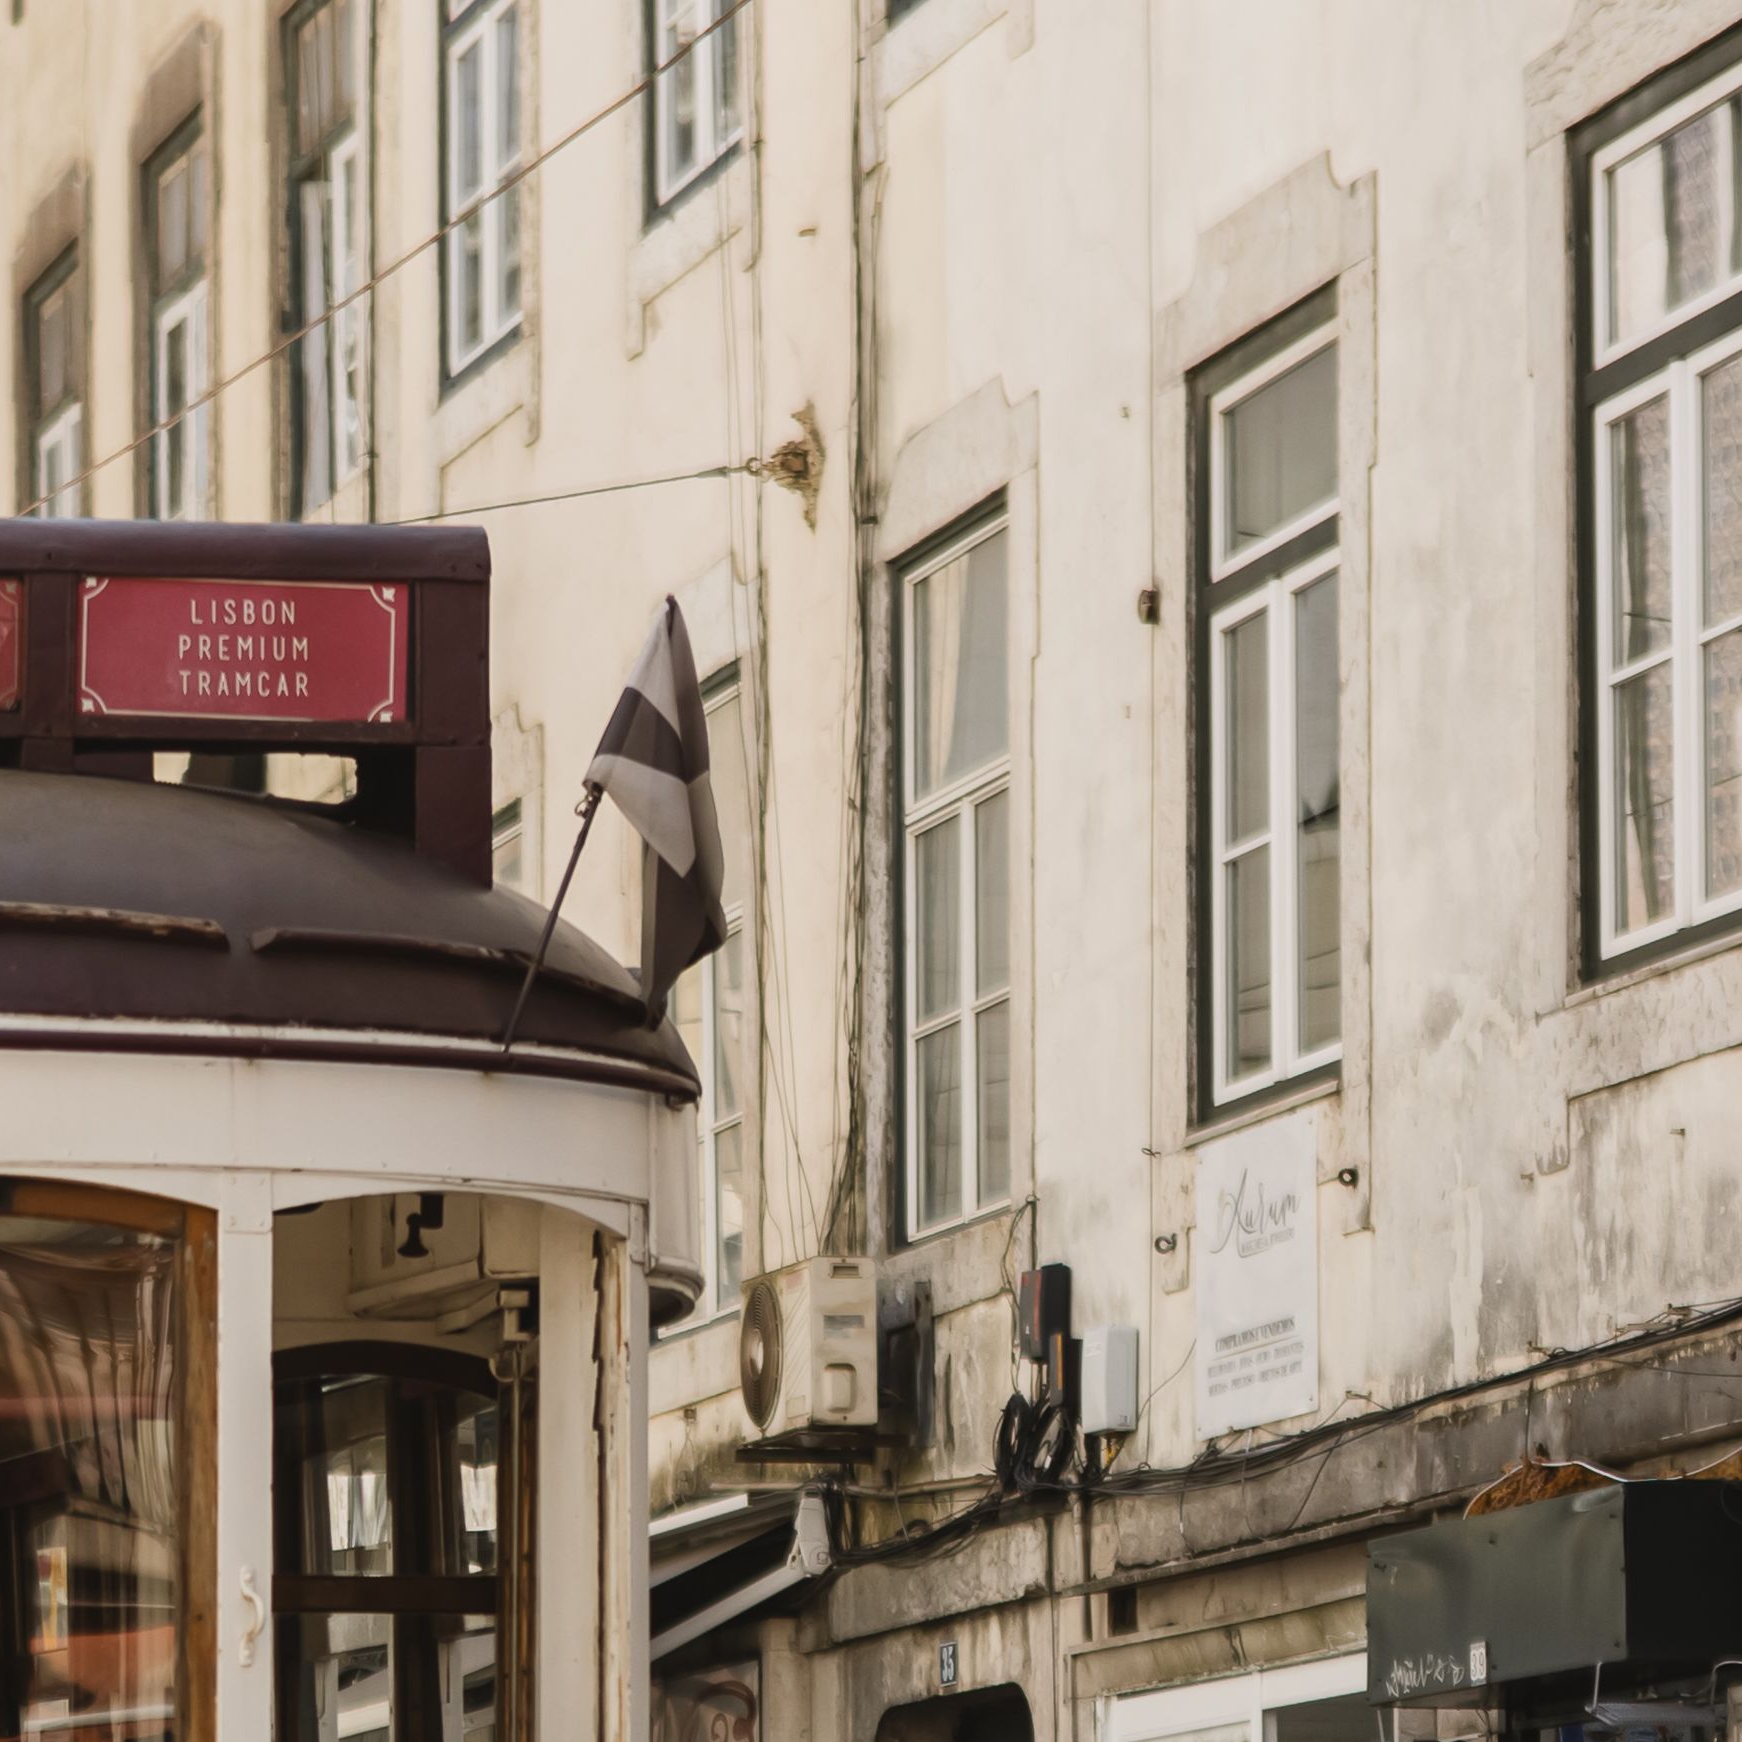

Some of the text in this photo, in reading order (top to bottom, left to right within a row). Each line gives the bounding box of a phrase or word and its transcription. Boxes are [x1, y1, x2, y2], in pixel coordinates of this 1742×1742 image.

[190, 598, 295, 625] LISBON
[178, 634, 309, 662] PREMIUM
[178, 669, 309, 698] TRAMCAR
[942, 1646, 955, 1682] 35
[1471, 1649, 1486, 1680] 39
